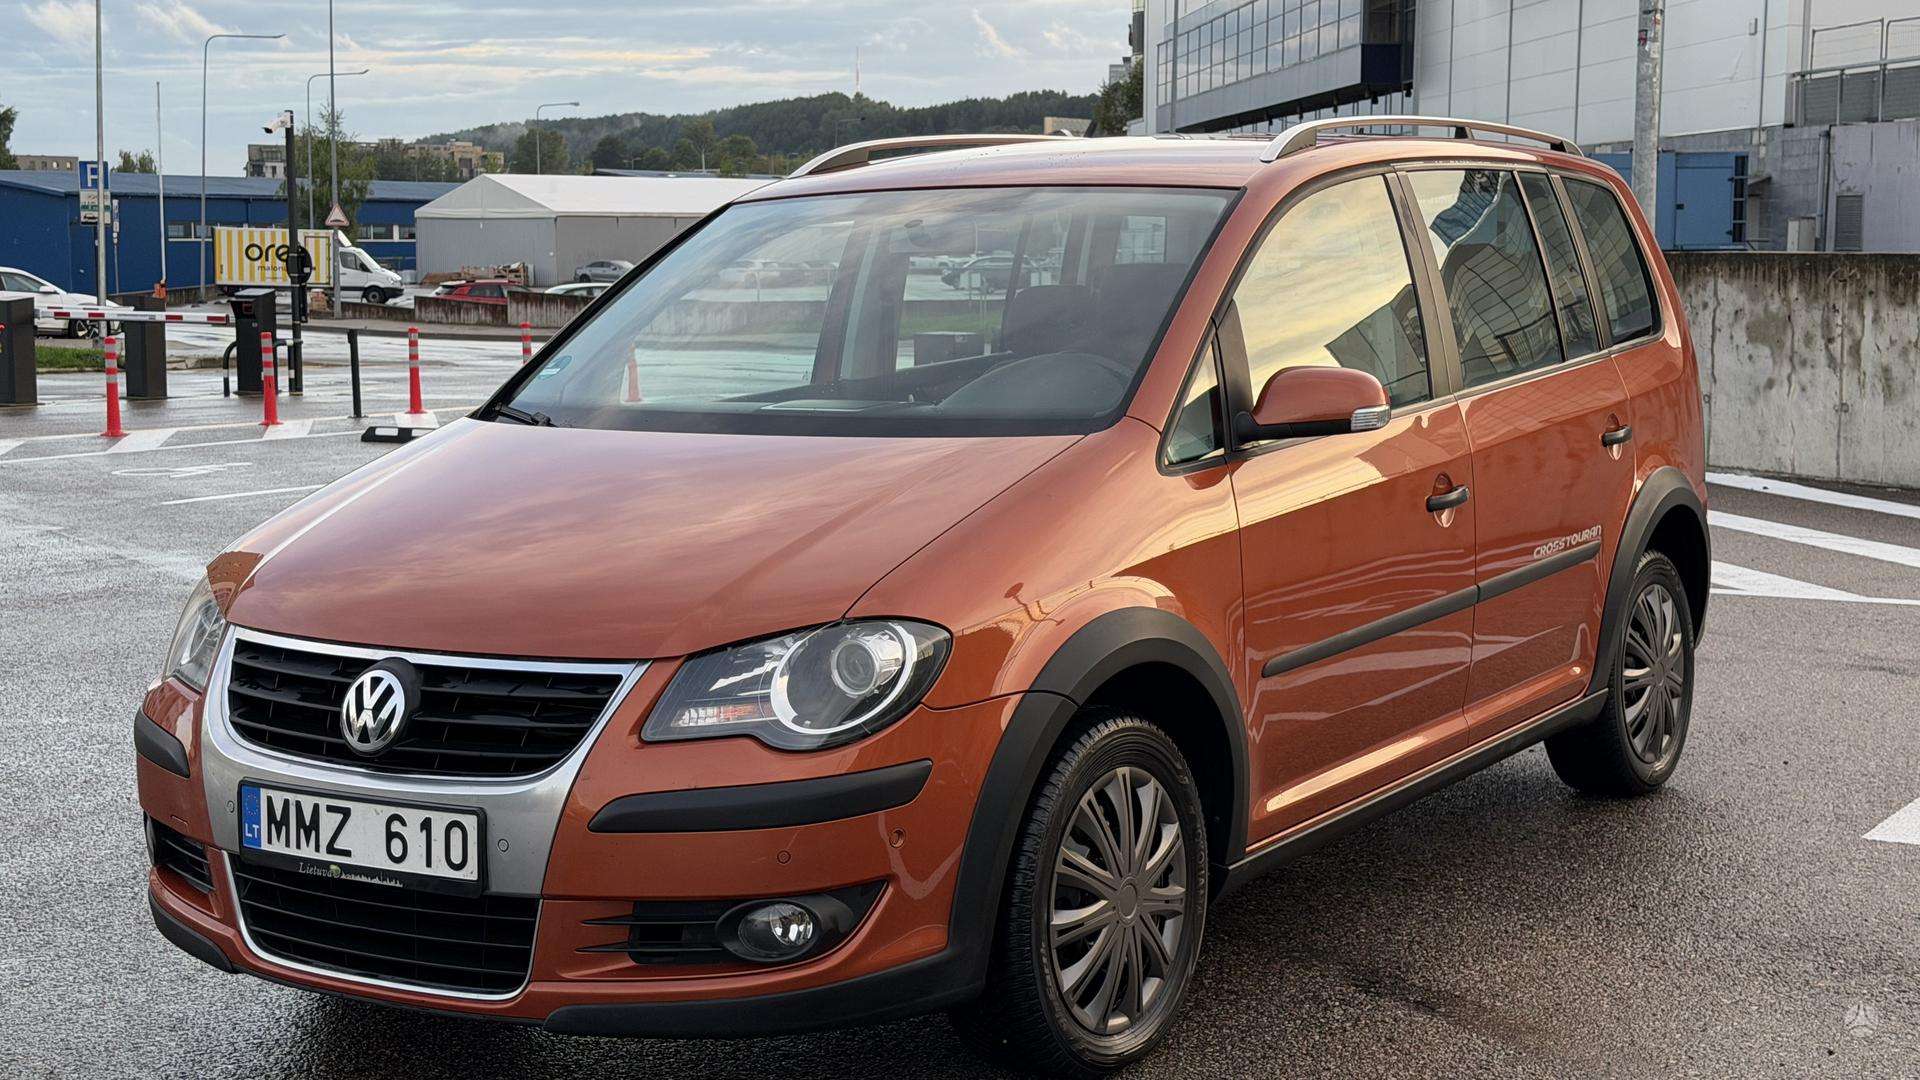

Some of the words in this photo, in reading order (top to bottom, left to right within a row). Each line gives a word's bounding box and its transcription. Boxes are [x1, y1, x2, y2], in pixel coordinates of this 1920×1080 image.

[1533, 525, 1602, 559] CROSSTOURAN
[245, 823, 260, 839] LT
[266, 795, 352, 858] MMZ
[385, 813, 469, 872] 610
